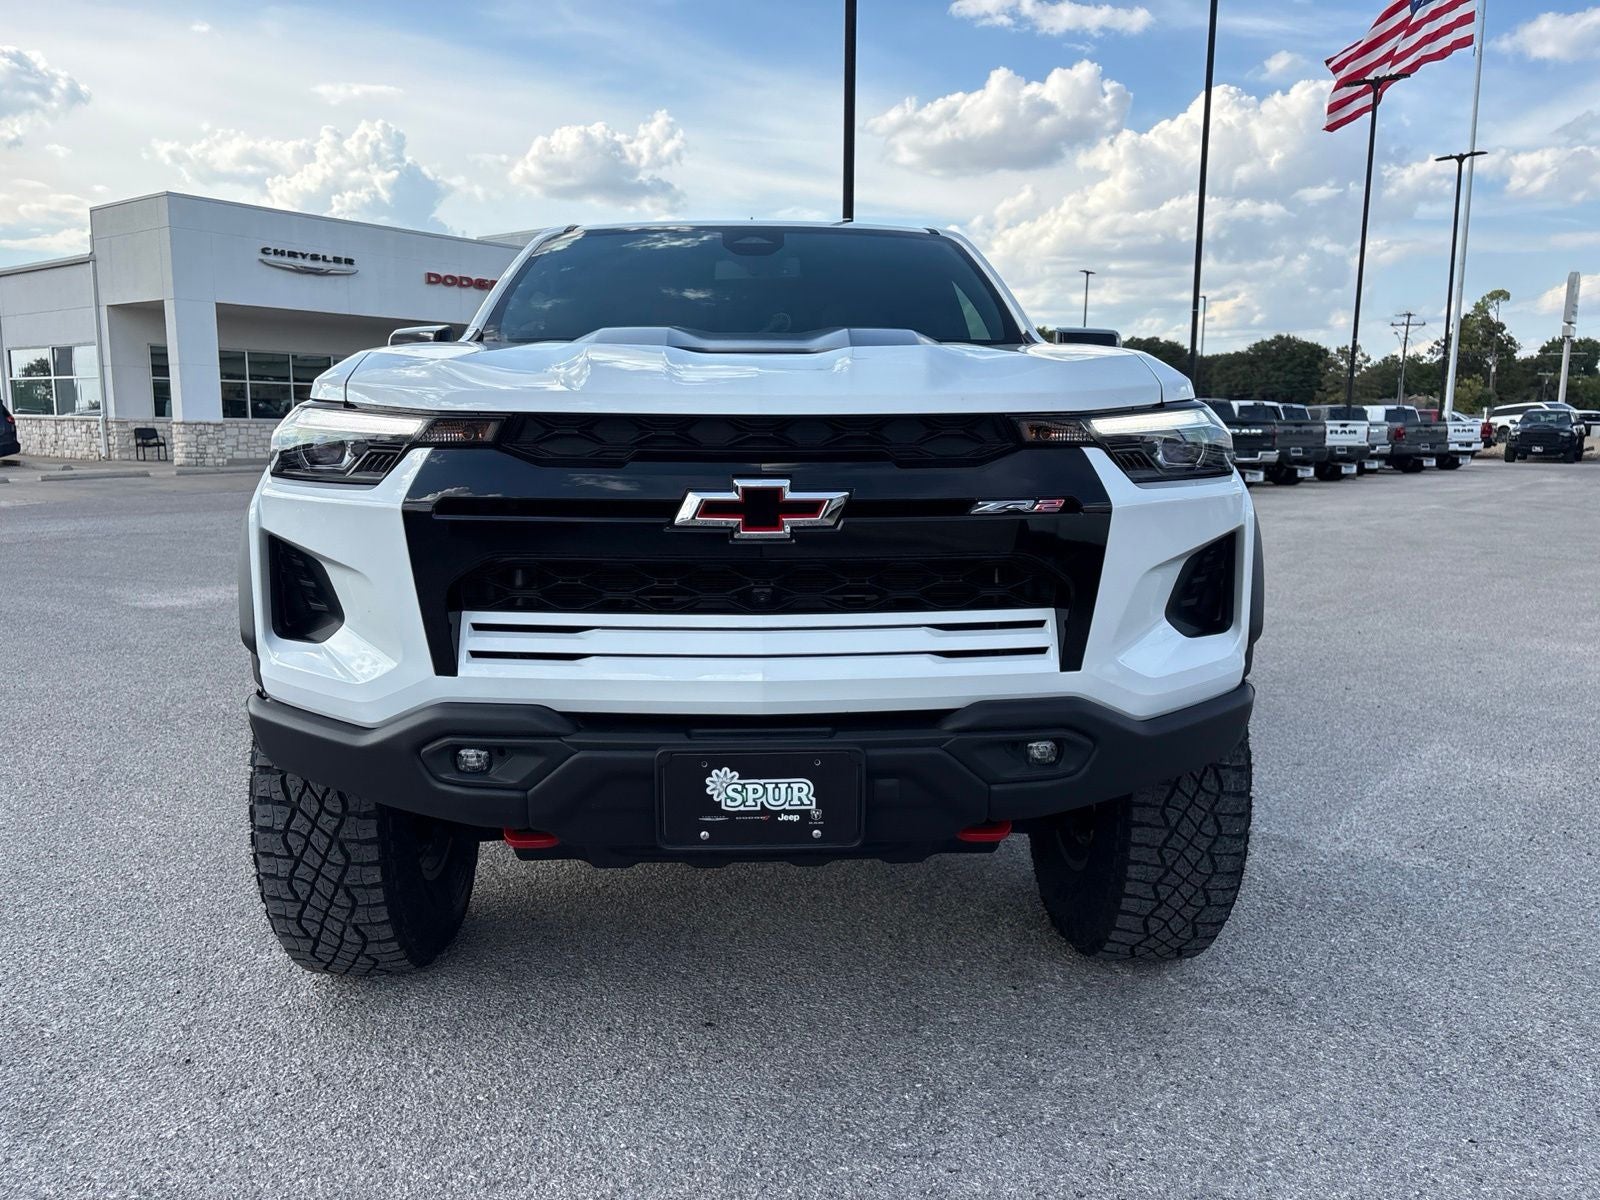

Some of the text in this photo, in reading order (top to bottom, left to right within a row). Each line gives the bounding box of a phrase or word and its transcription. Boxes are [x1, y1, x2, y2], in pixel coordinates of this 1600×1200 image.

[260, 247, 356, 265] CHRYSLER
[970, 499, 1066, 515] ZR2
[724, 782, 812, 808] SPUR
[777, 813, 800, 822] Jeep
